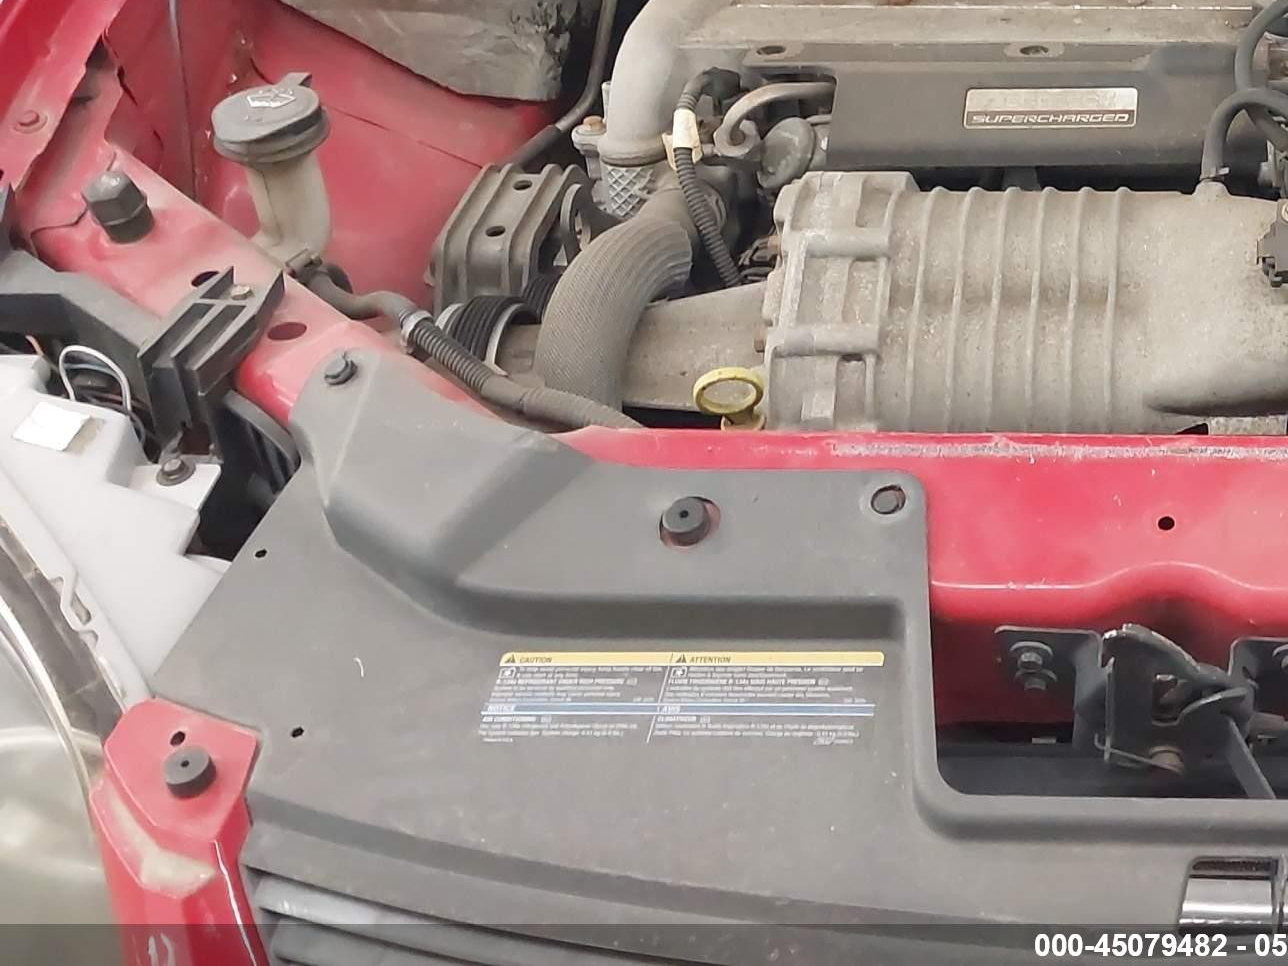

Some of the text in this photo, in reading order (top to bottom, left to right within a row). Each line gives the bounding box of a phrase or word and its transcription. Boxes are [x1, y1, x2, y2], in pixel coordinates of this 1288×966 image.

[971, 113, 1130, 124] SUPERCHARGED
[519, 656, 552, 664] CAUTION
[689, 656, 731, 664] ATTENTION
